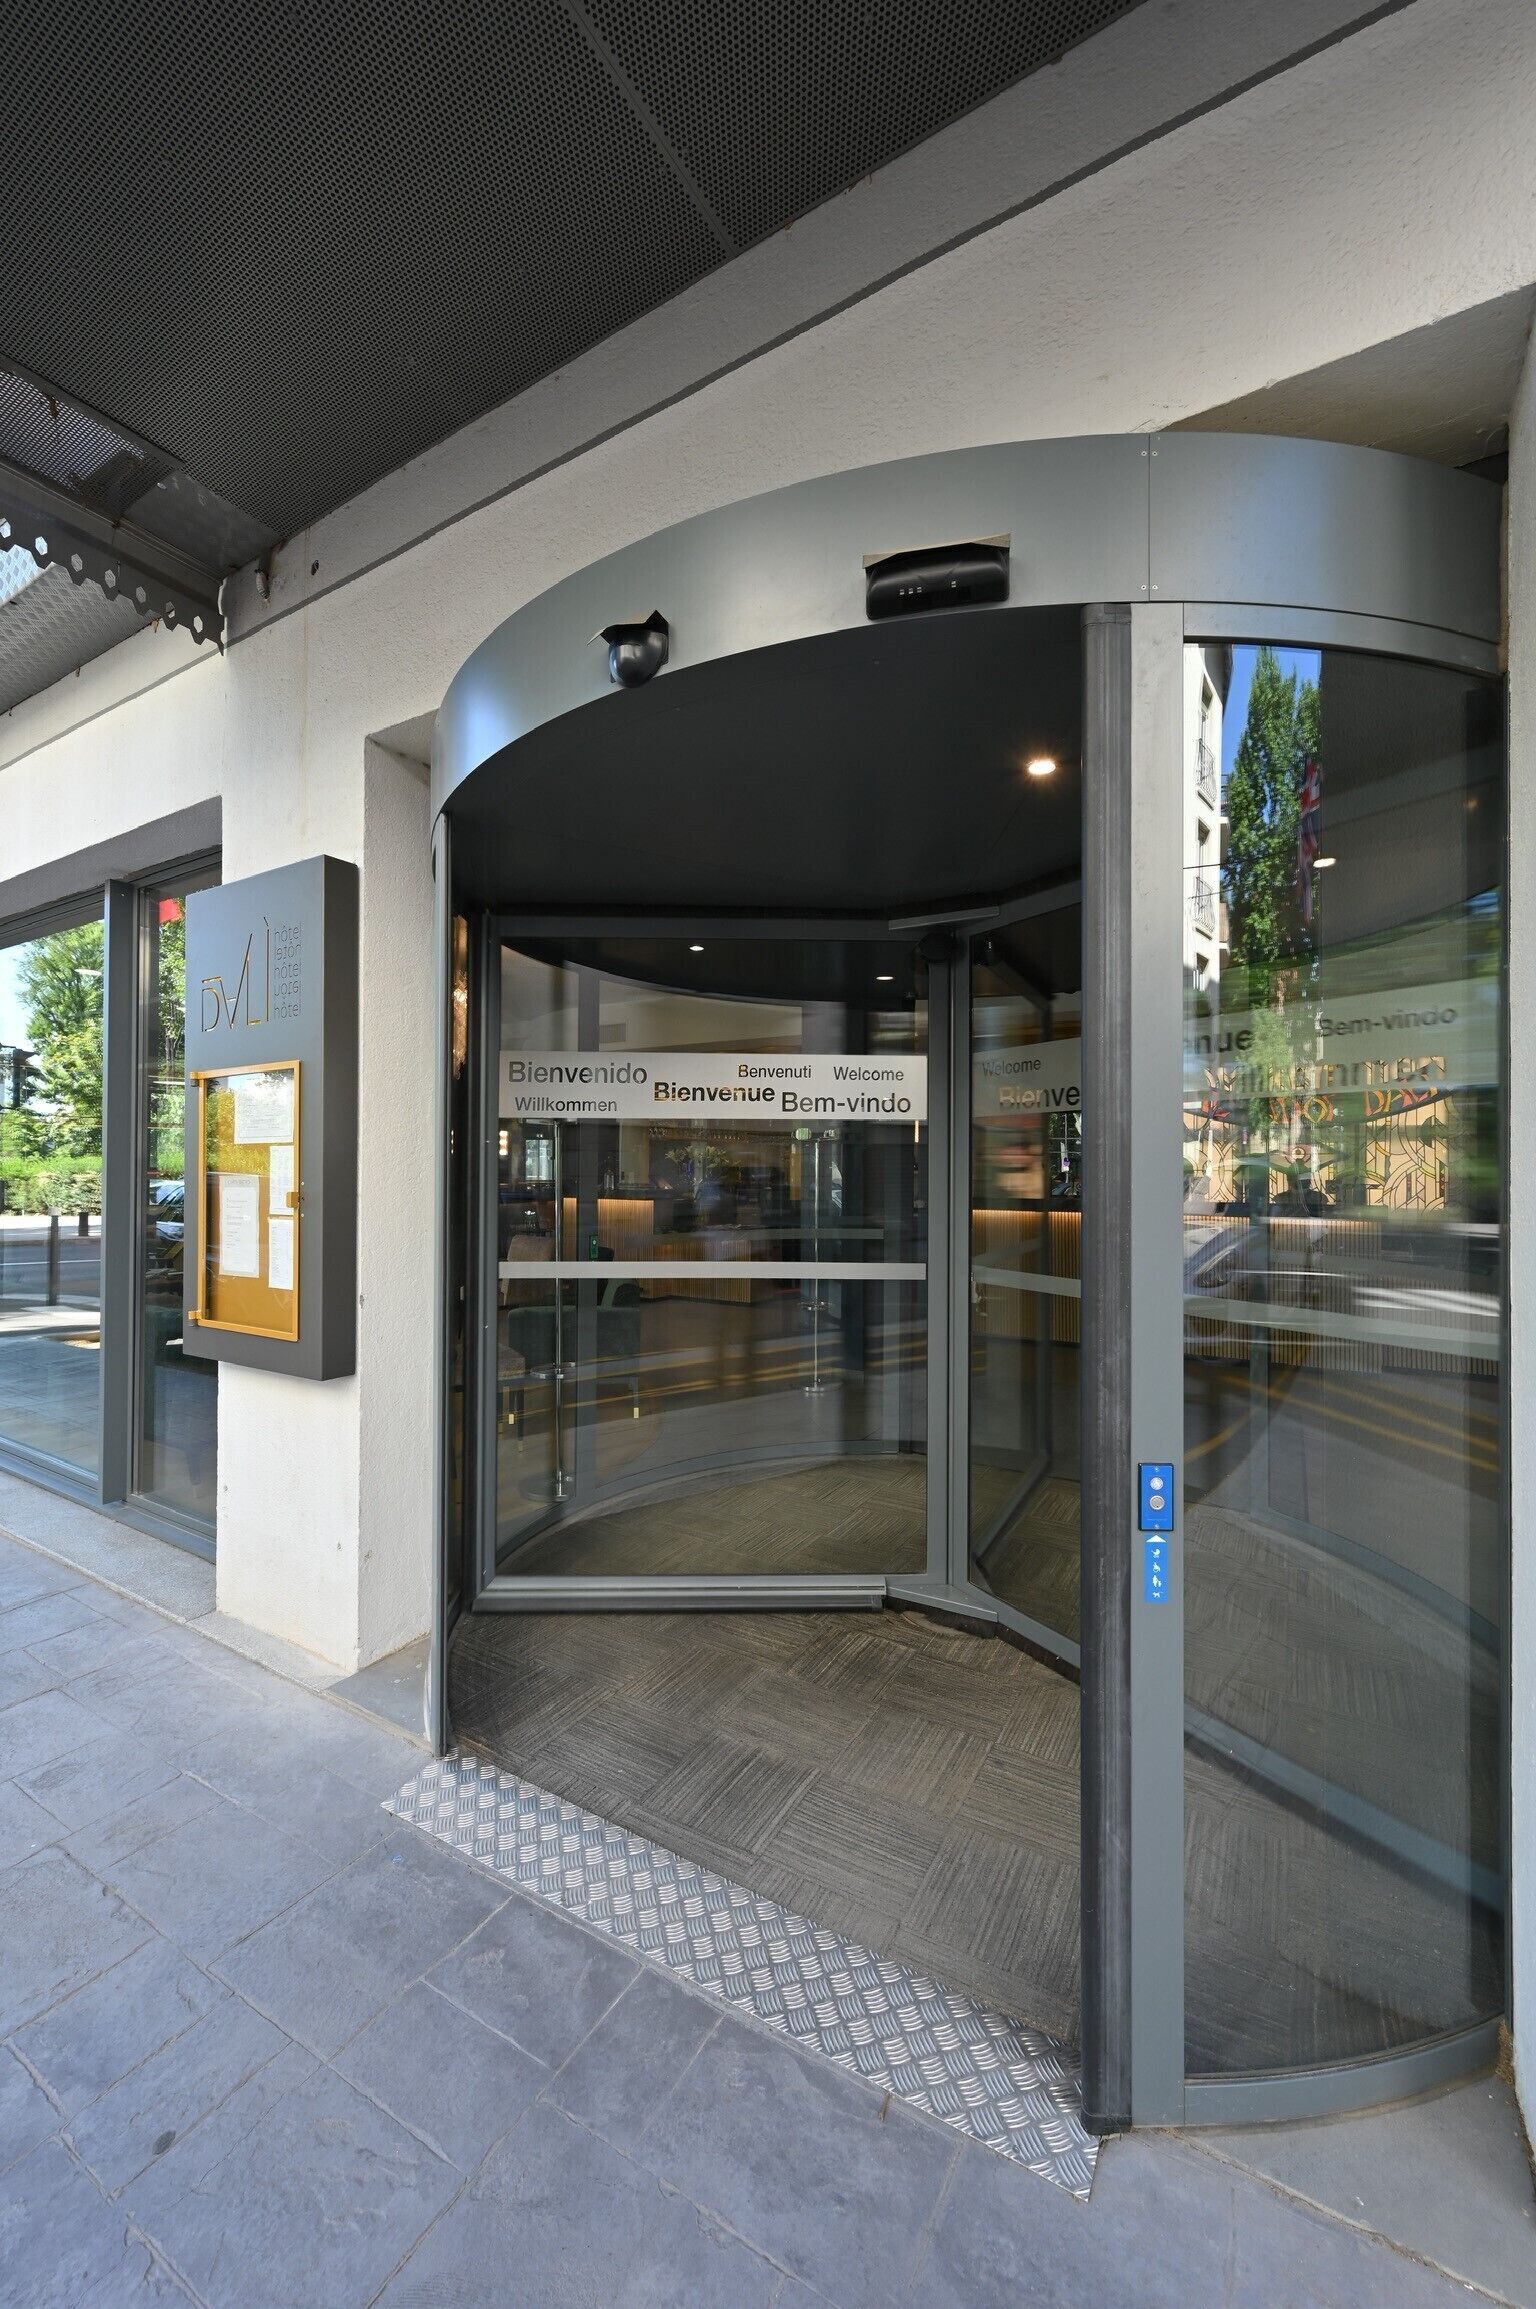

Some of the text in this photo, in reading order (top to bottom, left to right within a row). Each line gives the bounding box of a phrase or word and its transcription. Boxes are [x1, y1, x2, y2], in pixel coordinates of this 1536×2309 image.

[273, 921, 302, 942] hôtel
[273, 957, 302, 980] hôtel
[273, 996, 302, 1020] hôtel
[1318, 1006, 1459, 1038] Bem-vindo
[508, 1061, 648, 1085] Bienvenido
[738, 1064, 905, 1081] Benvenuti Welcome
[982, 1058, 1042, 1078] Welcome
[653, 1081, 776, 1103] Bienvenue
[781, 1091, 912, 1113] Bem-vindo
[514, 1096, 618, 1112] Willkommen
